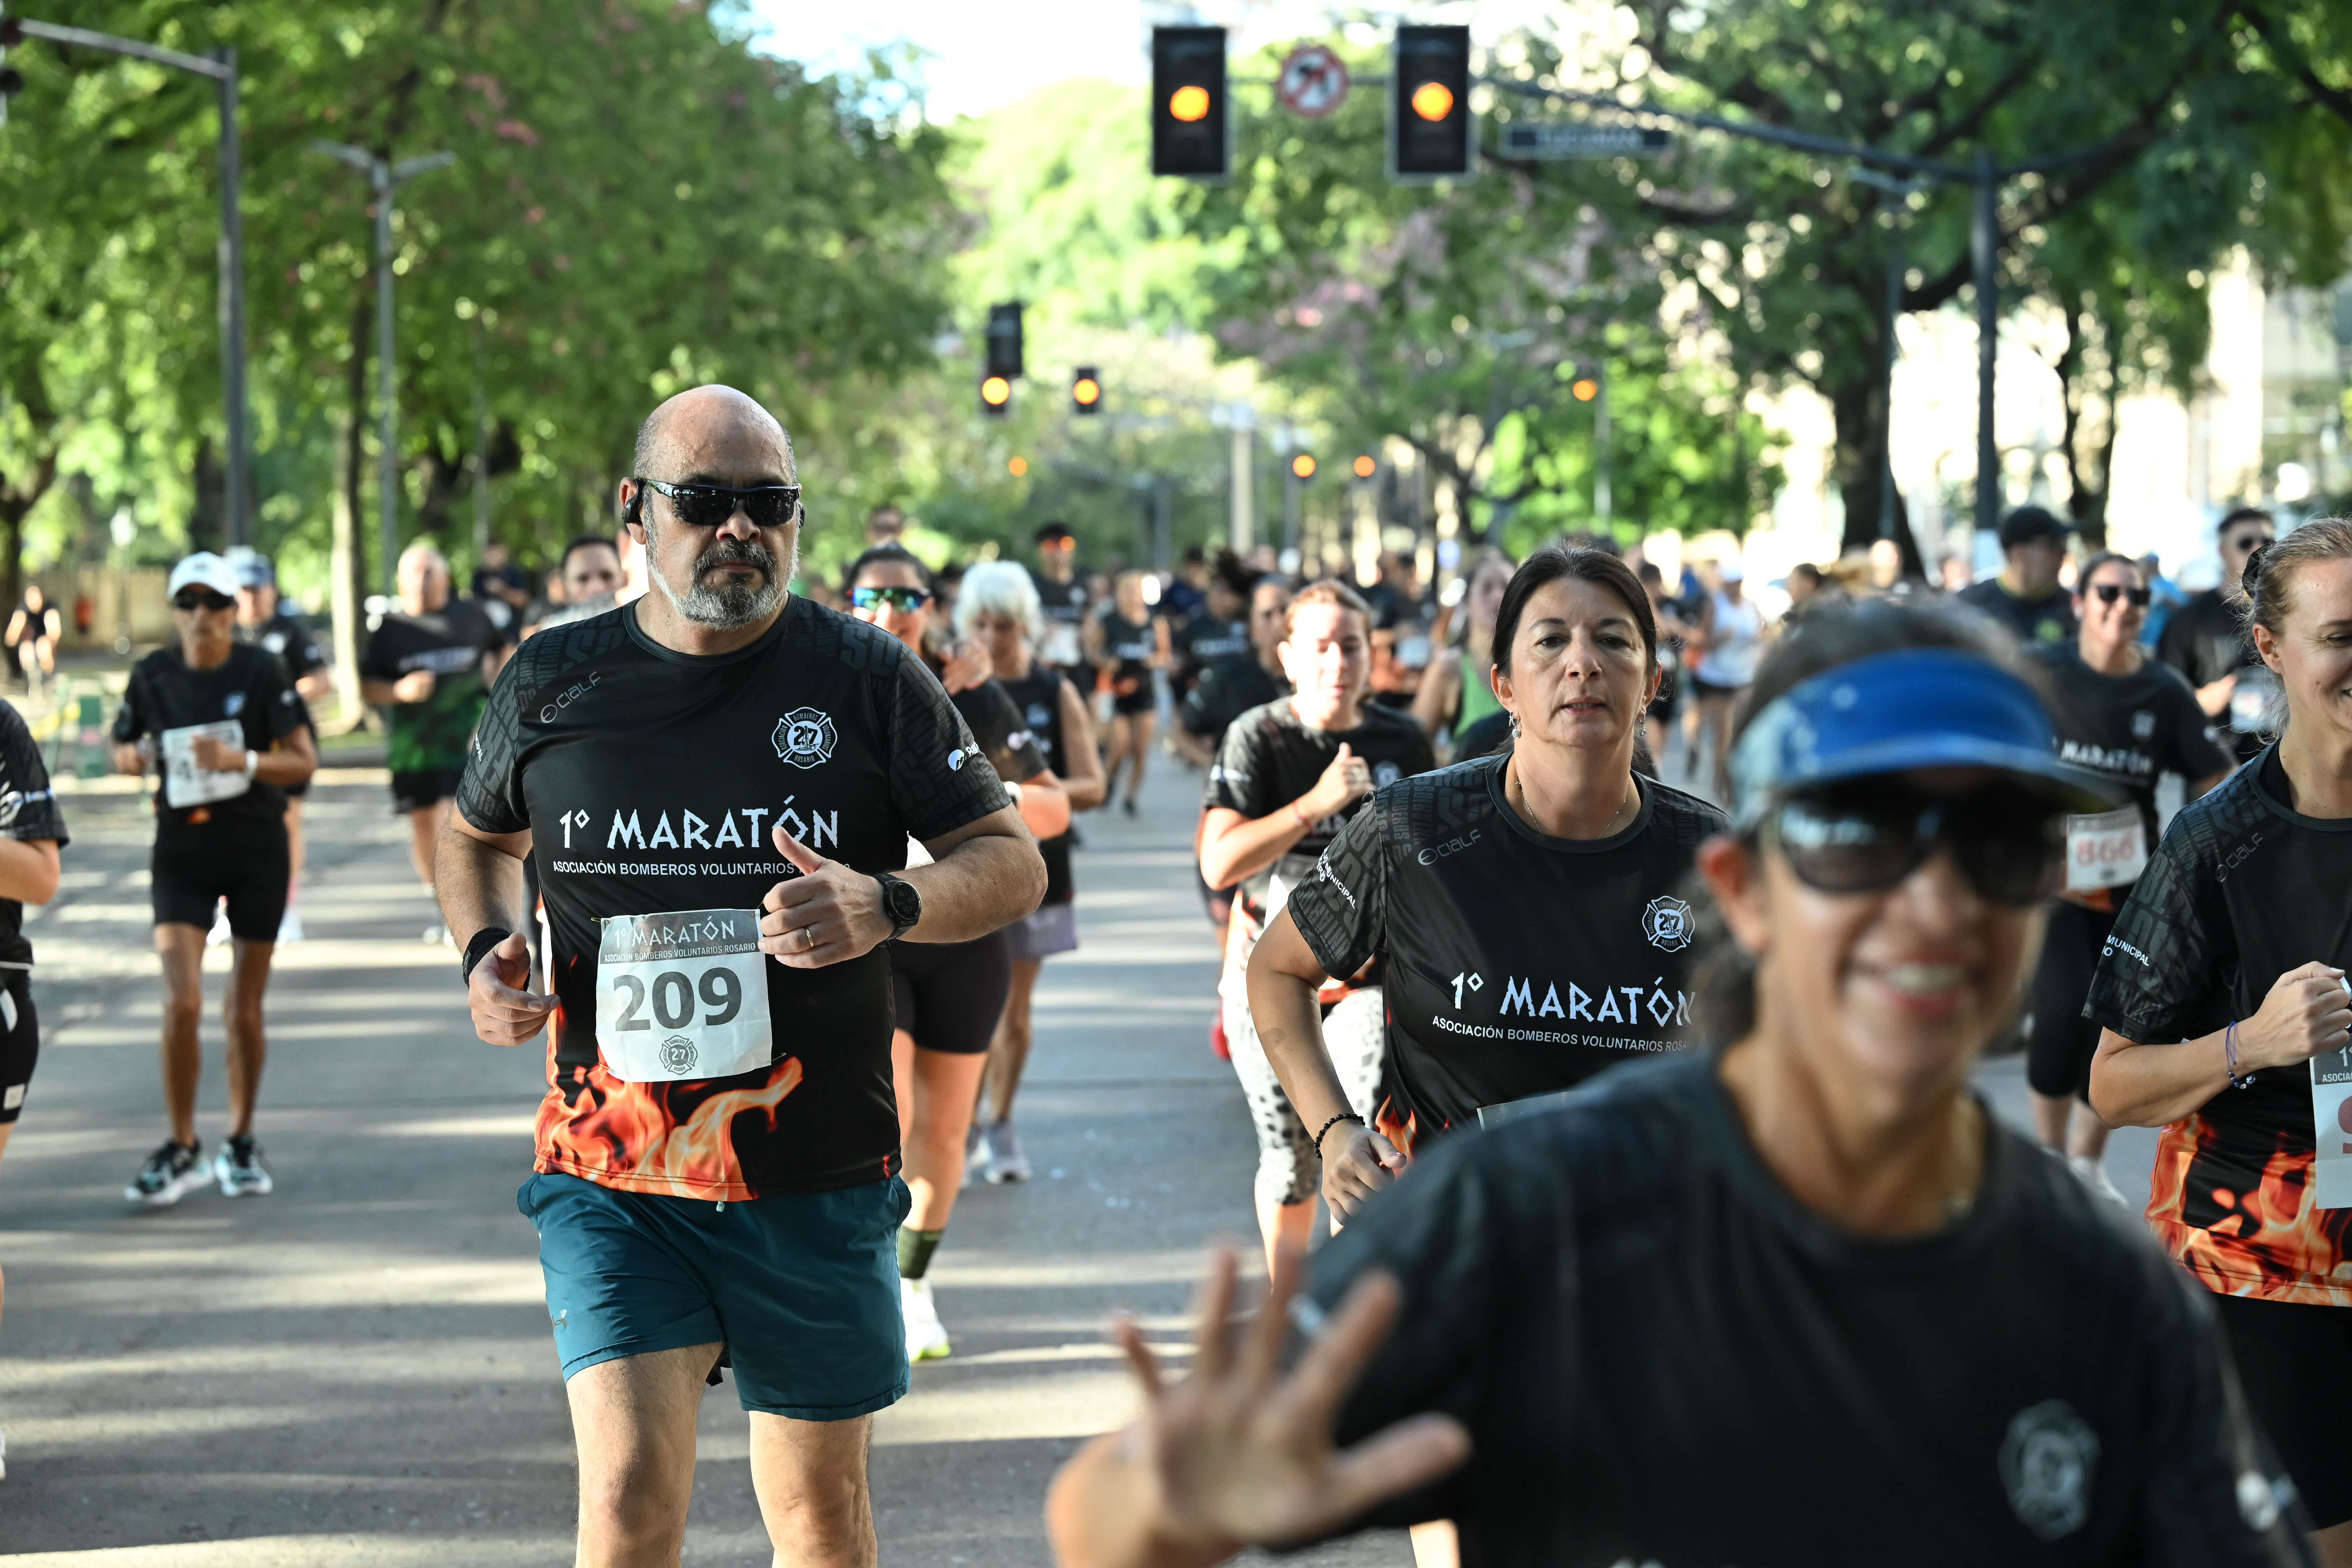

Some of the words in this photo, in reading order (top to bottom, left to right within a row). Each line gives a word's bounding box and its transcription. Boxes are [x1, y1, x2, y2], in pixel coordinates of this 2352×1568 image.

[793, 712, 818, 721] BOMBEROS
[794, 725, 818, 746] 27
[822, 724, 831, 751] VOLUNTARIOS
[607, 794, 838, 849] MARATÓN
[553, 860, 616, 875] ASOCIACIÓN
[620, 863, 696, 876] BOMBEROS
[700, 863, 795, 875] VOLUNTARIOS
[1325, 862, 1356, 910] MUNICIPAL
[632, 916, 735, 947] MARATÓN
[1659, 913, 1680, 931] 27
[604, 951, 633, 962] ASOCIACIÓN
[635, 950, 672, 961] BOMBEROS
[674, 945, 722, 957] VOLUNTARIOS
[724, 942, 756, 953] ROSARIO
[2106, 934, 2149, 966] MUNICIPAL
[613, 967, 742, 1032] 209
[1500, 976, 1695, 1027] MARATÓN
[1433, 1015, 1503, 1039] ASOCIACIÓN
[1507, 1029, 1578, 1045] BOMBEROS
[1582, 1035, 1663, 1052] VOLUNTARIOS
[671, 1048, 686, 1061] 27
